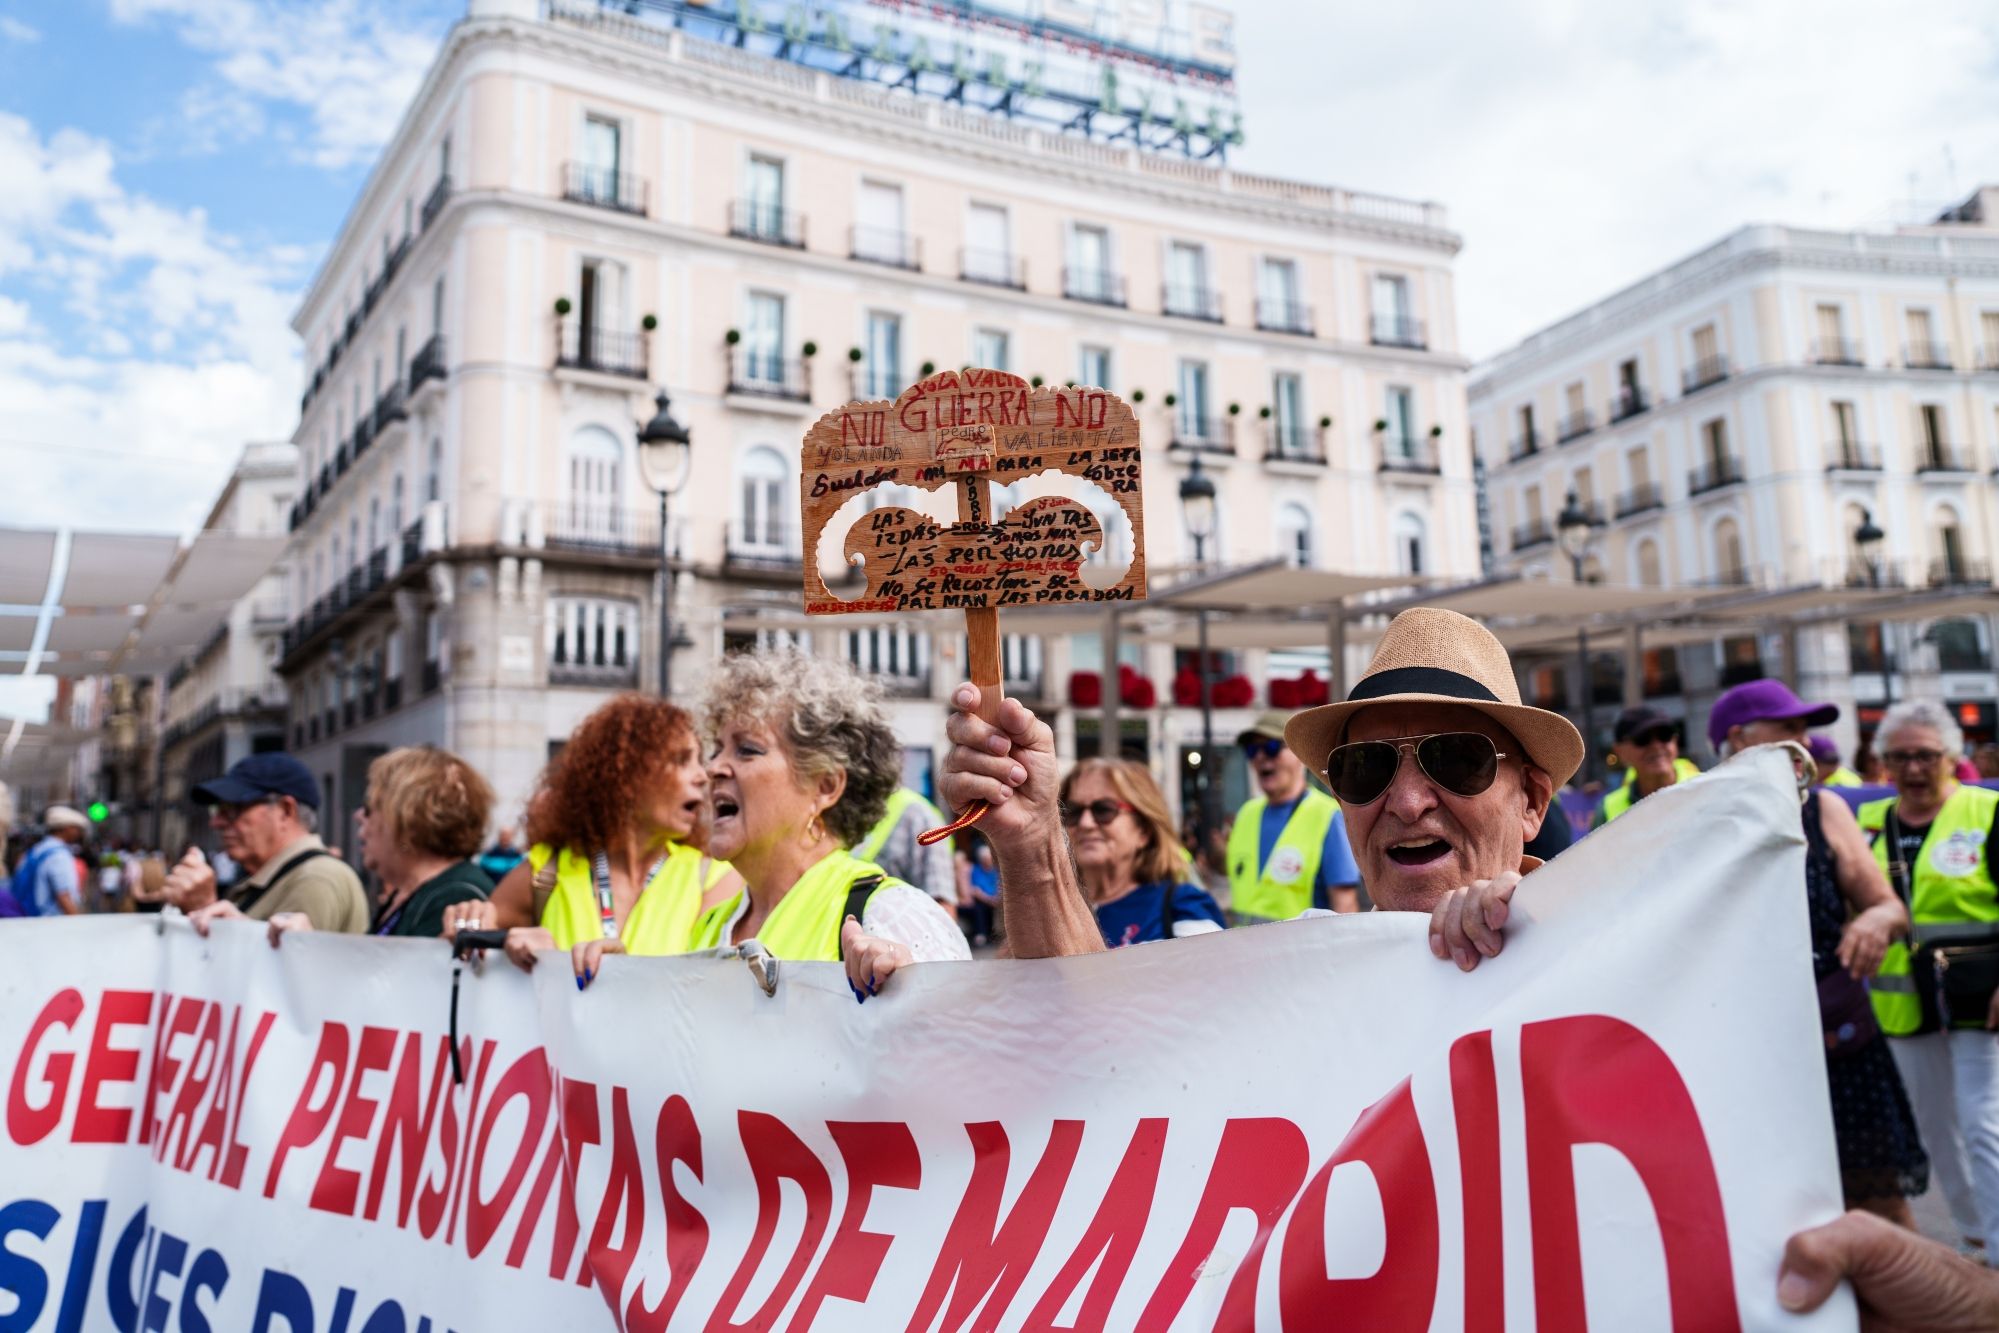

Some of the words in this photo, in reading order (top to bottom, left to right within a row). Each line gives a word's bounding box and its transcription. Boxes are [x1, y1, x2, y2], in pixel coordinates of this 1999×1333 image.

[842, 410, 886, 447] NO
[900, 390, 1031, 433] GUERRA
[1055, 390, 1108, 430] NO
[1004, 427, 1125, 450] VALIENTE
[872, 510, 905, 531] LAS
